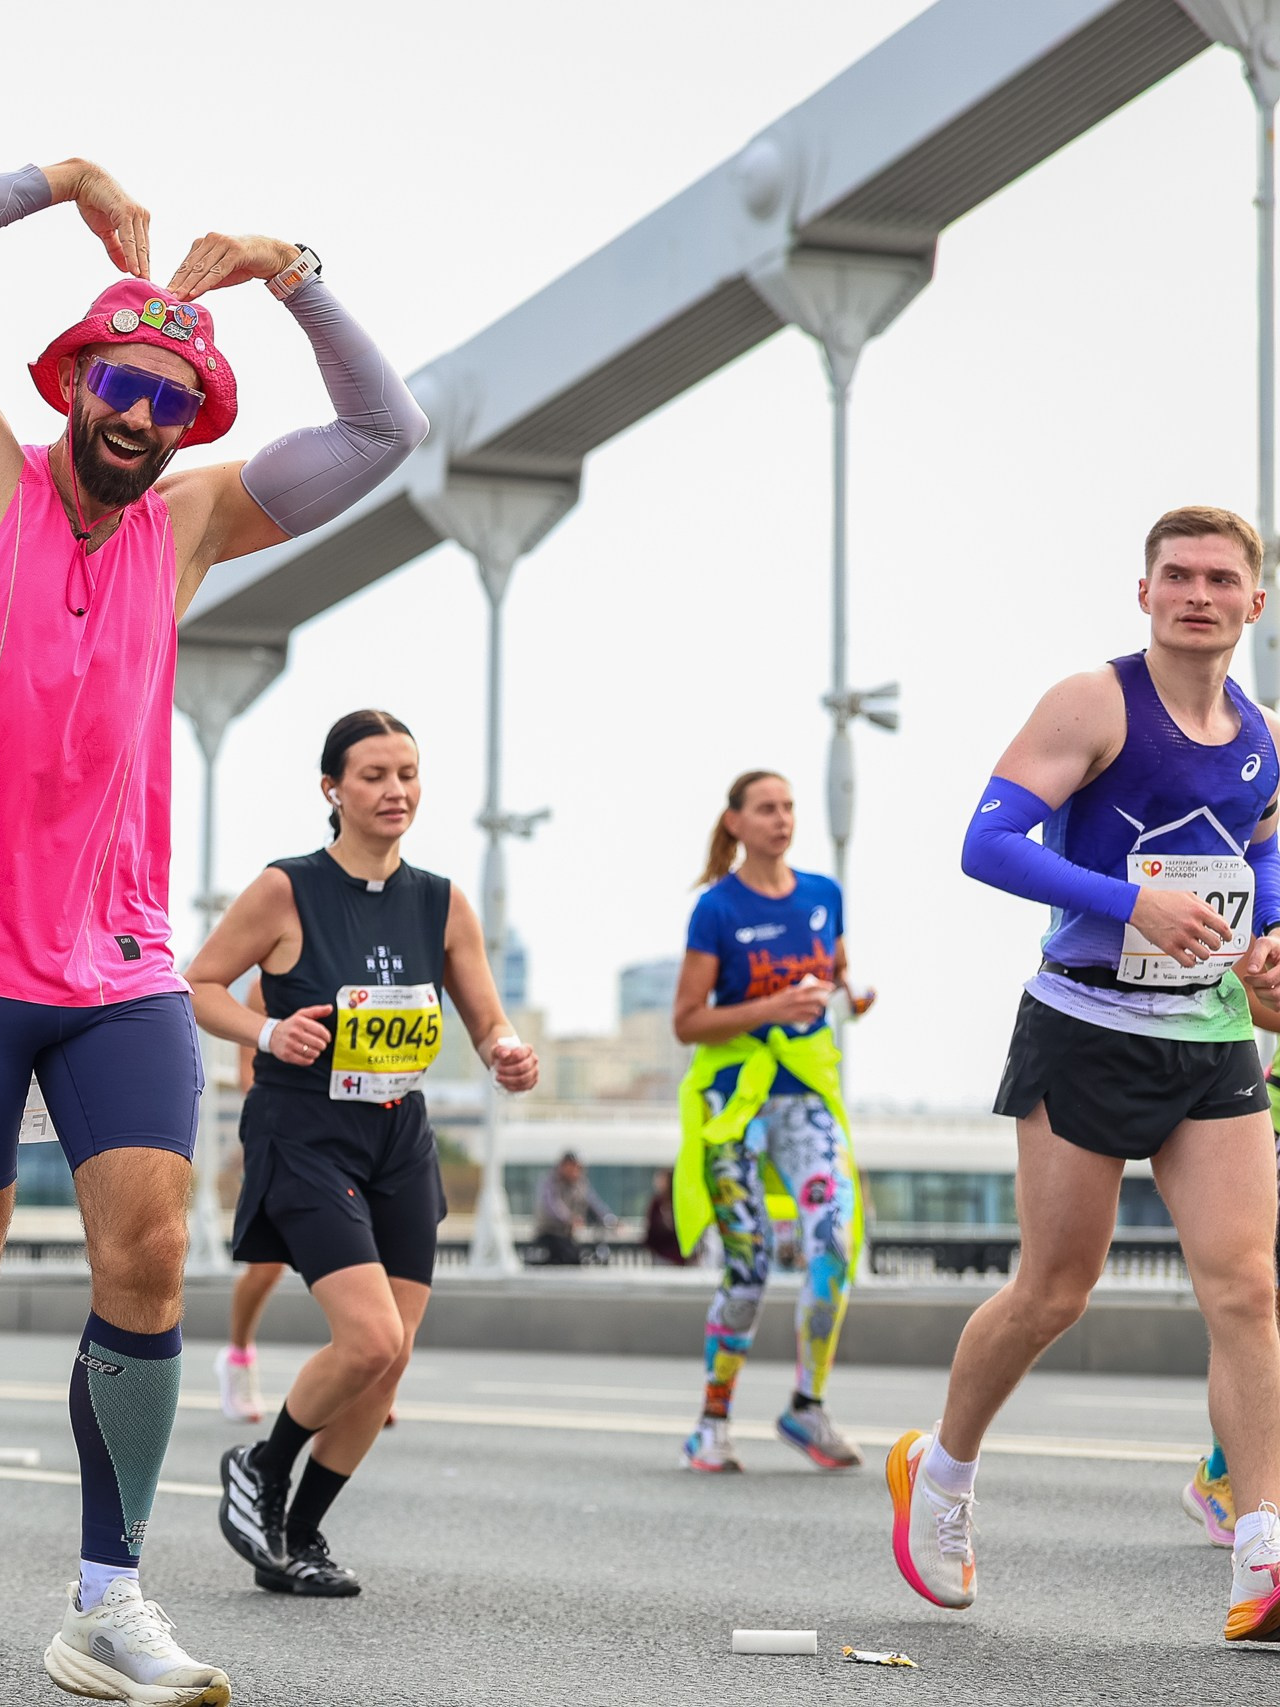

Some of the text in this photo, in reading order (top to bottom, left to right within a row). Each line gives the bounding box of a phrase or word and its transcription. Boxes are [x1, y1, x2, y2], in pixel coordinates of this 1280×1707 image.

[311, 423, 336, 435] EMIX
[265, 438, 288, 455] RUN
[1133, 959, 1147, 980] J
[346, 1014, 438, 1049] 19045
[367, 1054, 418, 1065] ЕКАТЕРИНА
